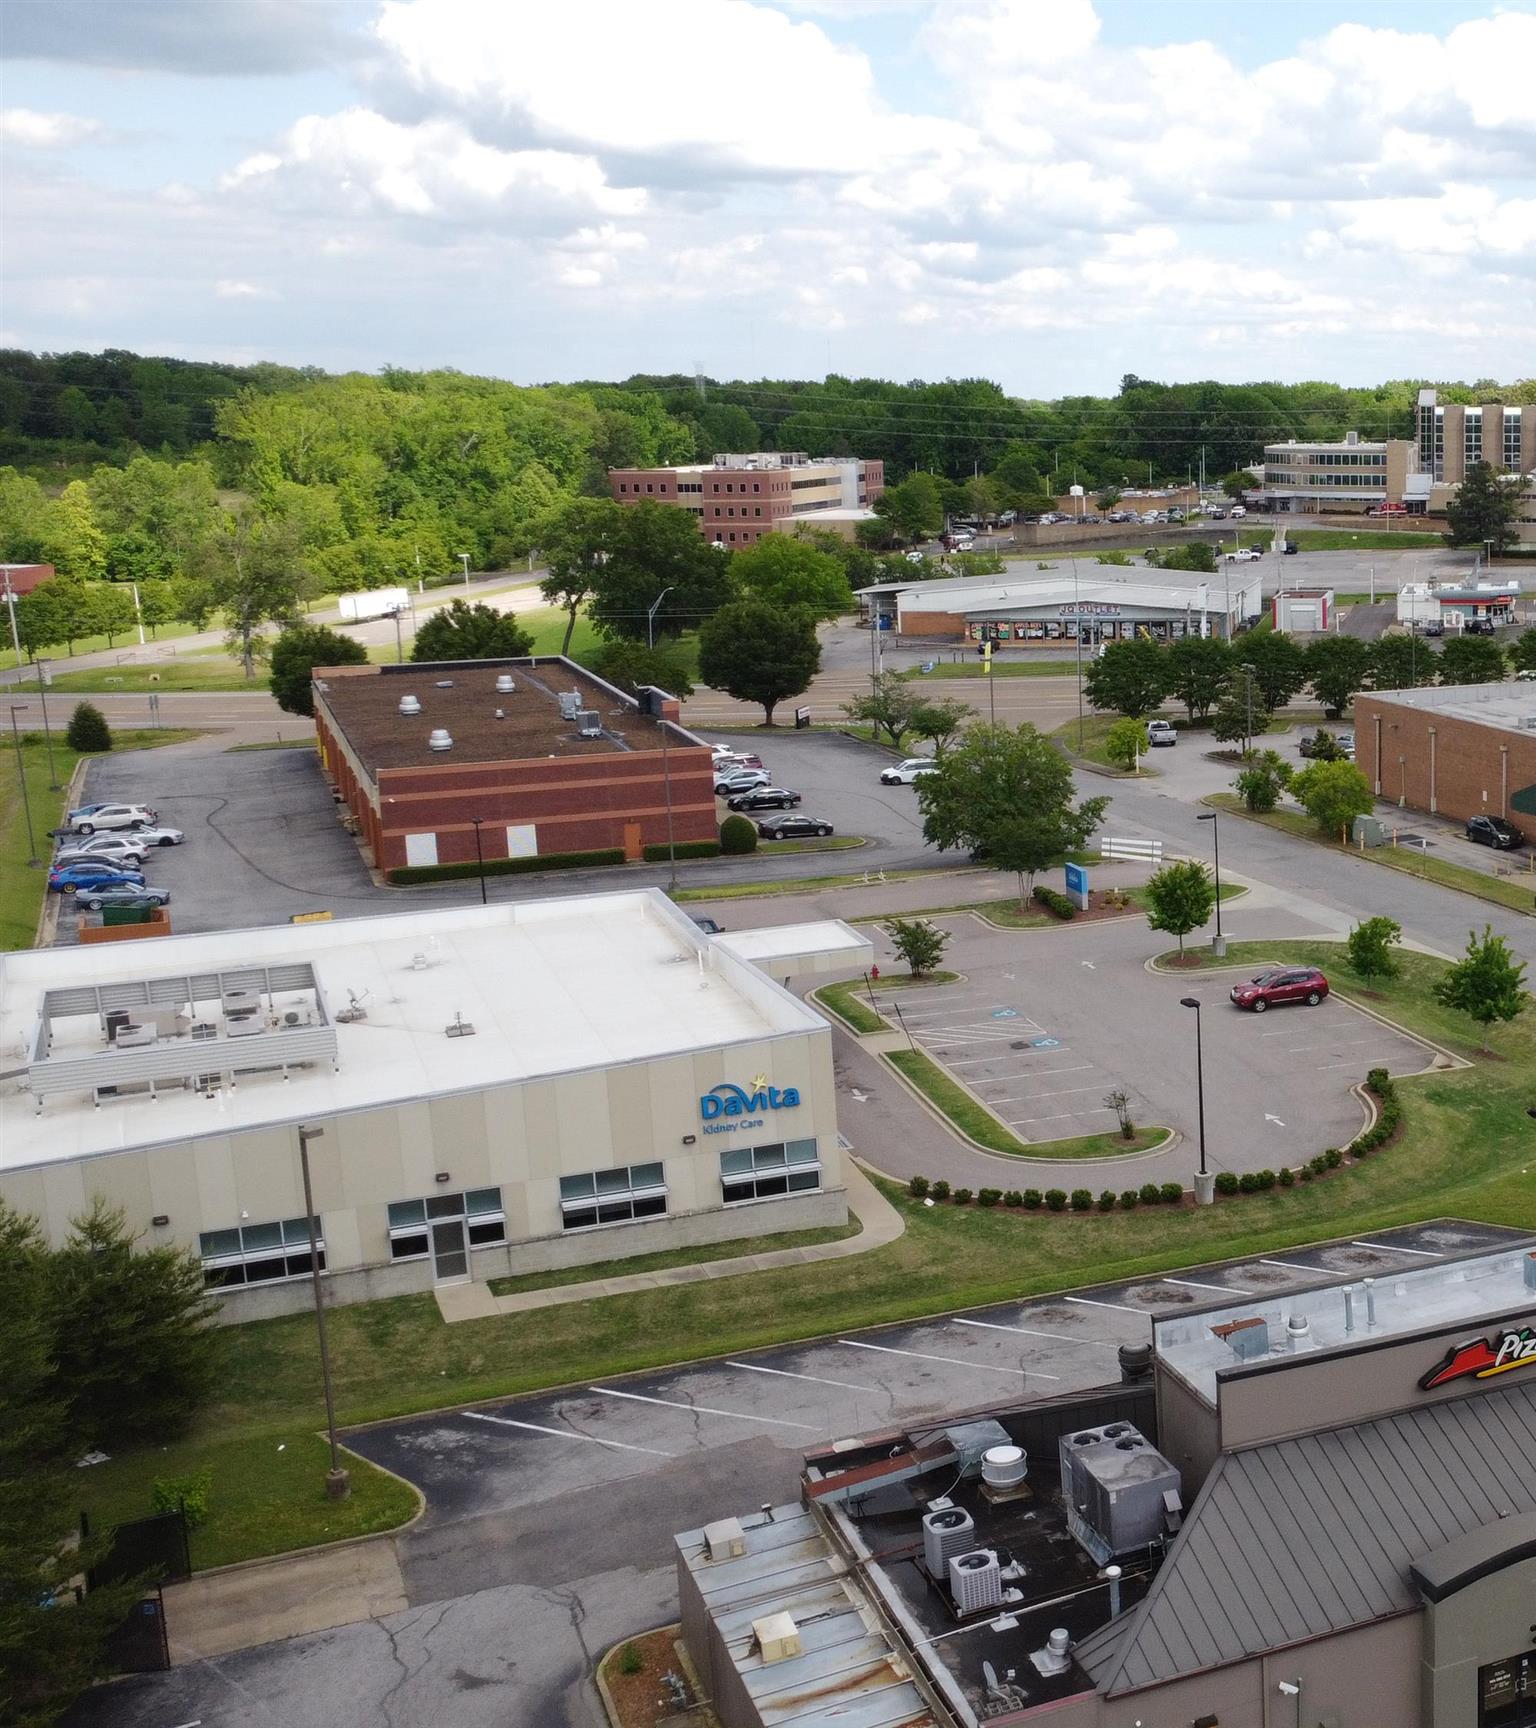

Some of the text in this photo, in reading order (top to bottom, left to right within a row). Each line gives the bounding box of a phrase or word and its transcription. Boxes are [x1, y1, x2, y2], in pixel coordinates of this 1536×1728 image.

[1061, 605, 1119, 613] JQ OUTLET
[701, 1081, 800, 1120] DaVita
[703, 1119, 764, 1135] Kidney Care
